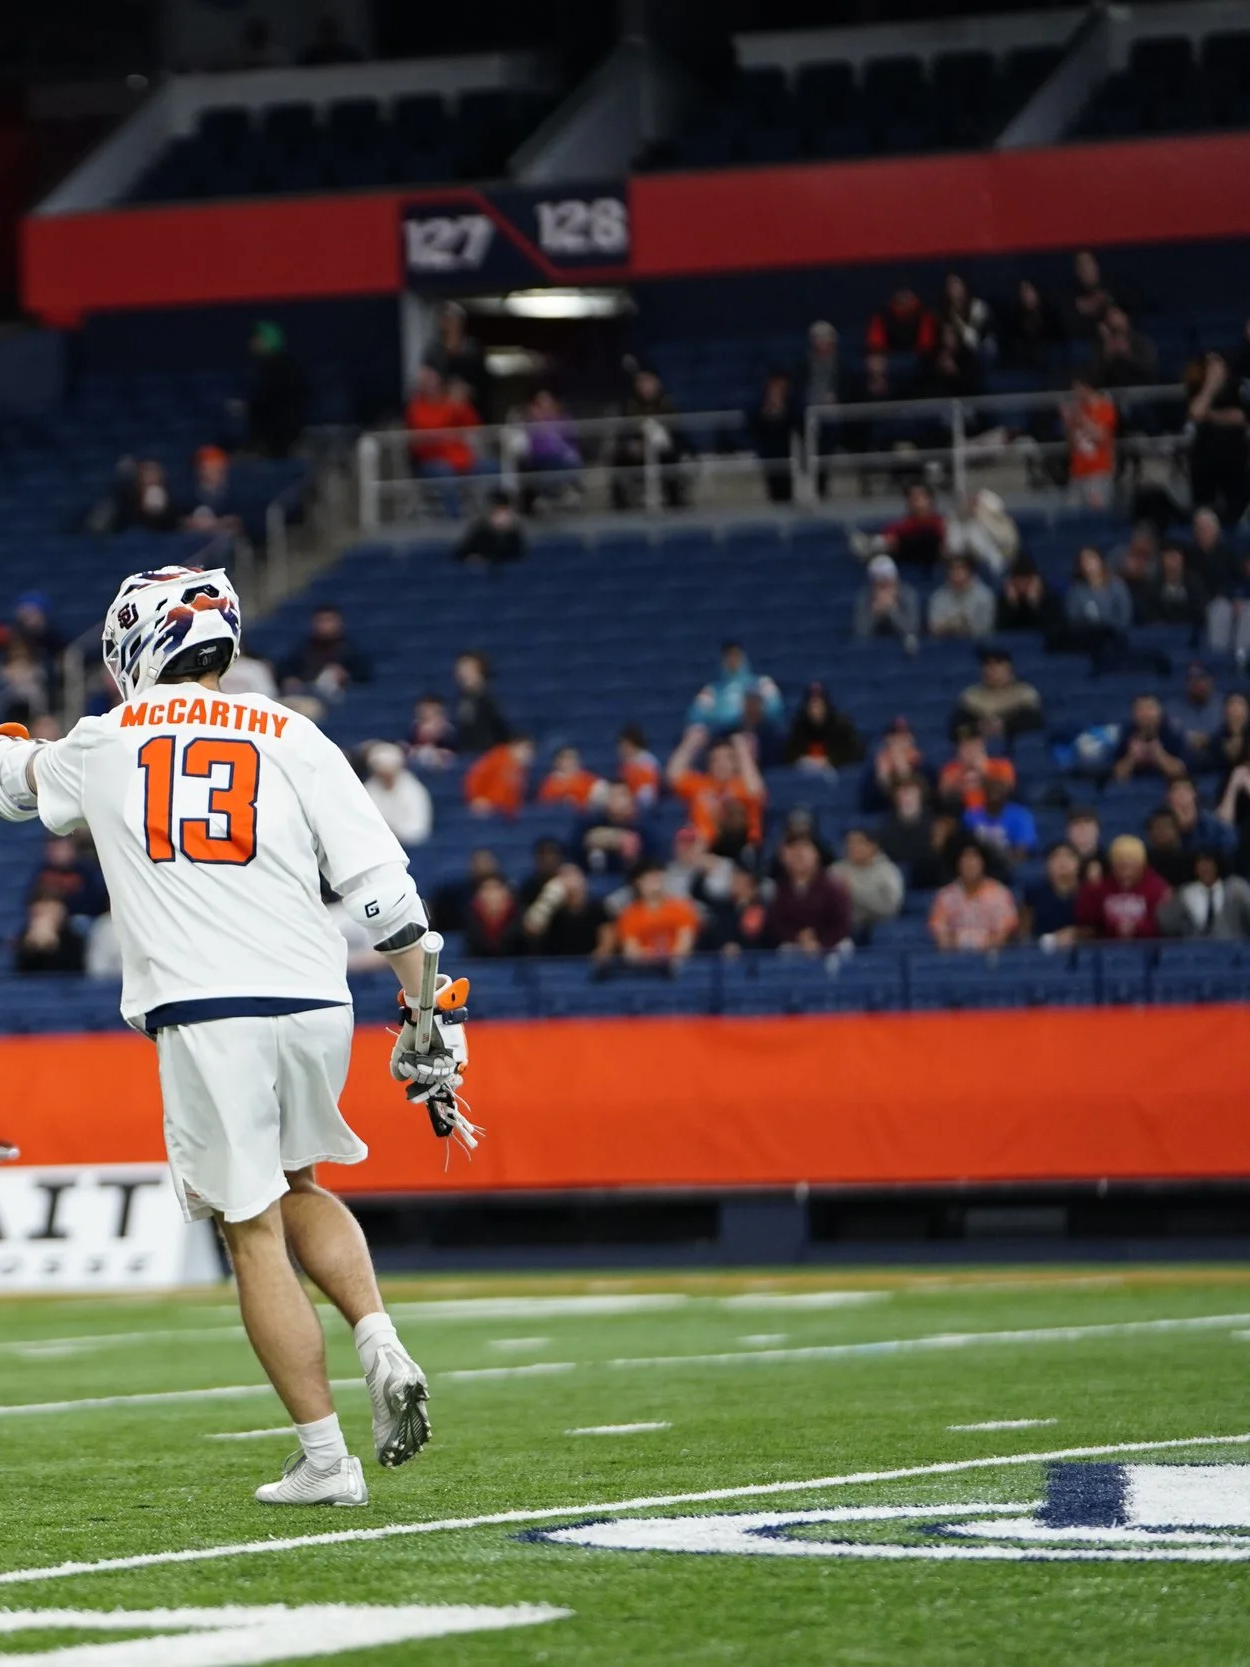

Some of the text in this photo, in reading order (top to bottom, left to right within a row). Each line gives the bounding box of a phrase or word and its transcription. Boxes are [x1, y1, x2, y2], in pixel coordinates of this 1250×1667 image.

[403, 215, 496, 272] 127
[534, 198, 630, 253] 128
[120, 698, 290, 739] McCARTHY
[137, 735, 261, 867] 13
